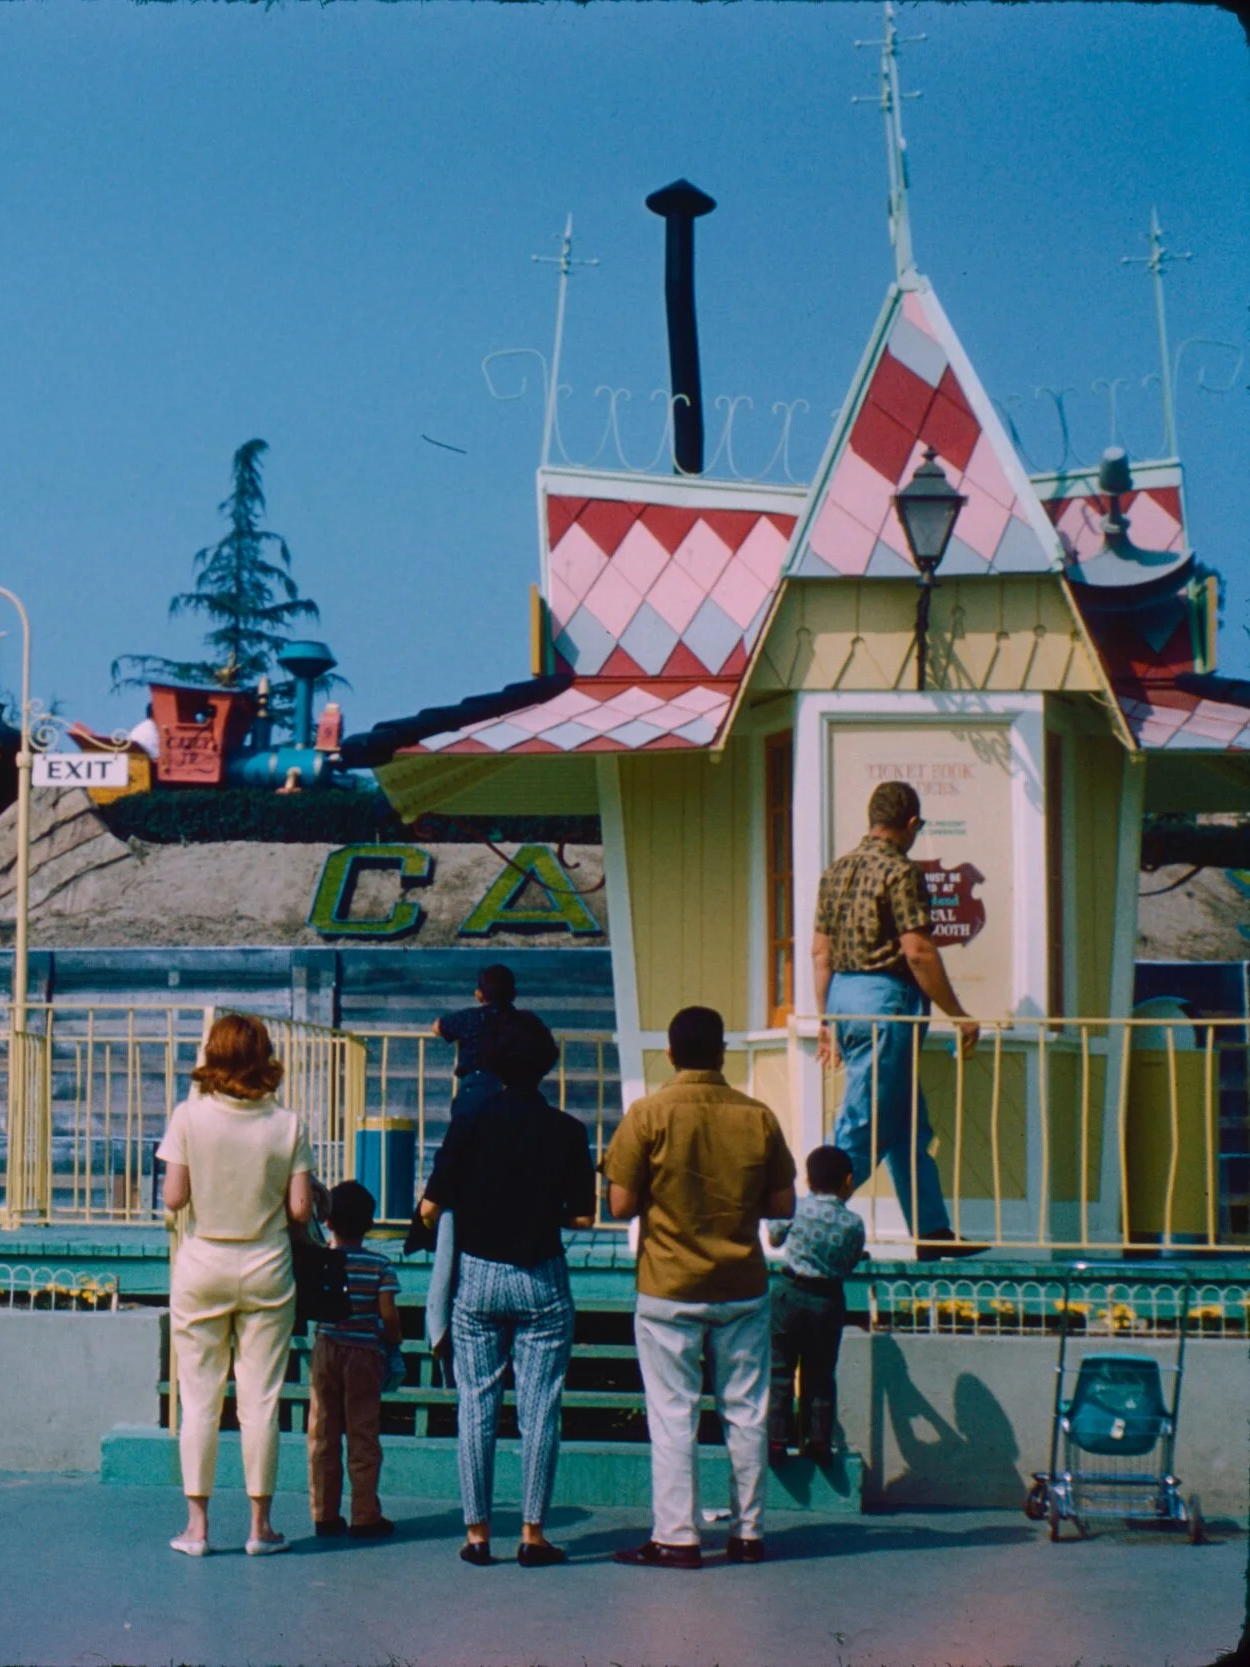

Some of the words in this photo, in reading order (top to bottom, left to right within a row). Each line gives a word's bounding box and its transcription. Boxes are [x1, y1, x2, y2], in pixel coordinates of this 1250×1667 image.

[47, 760, 113, 779] EXIT
[866, 763, 928, 779] TICKET
[930, 763, 976, 779] BOOK
